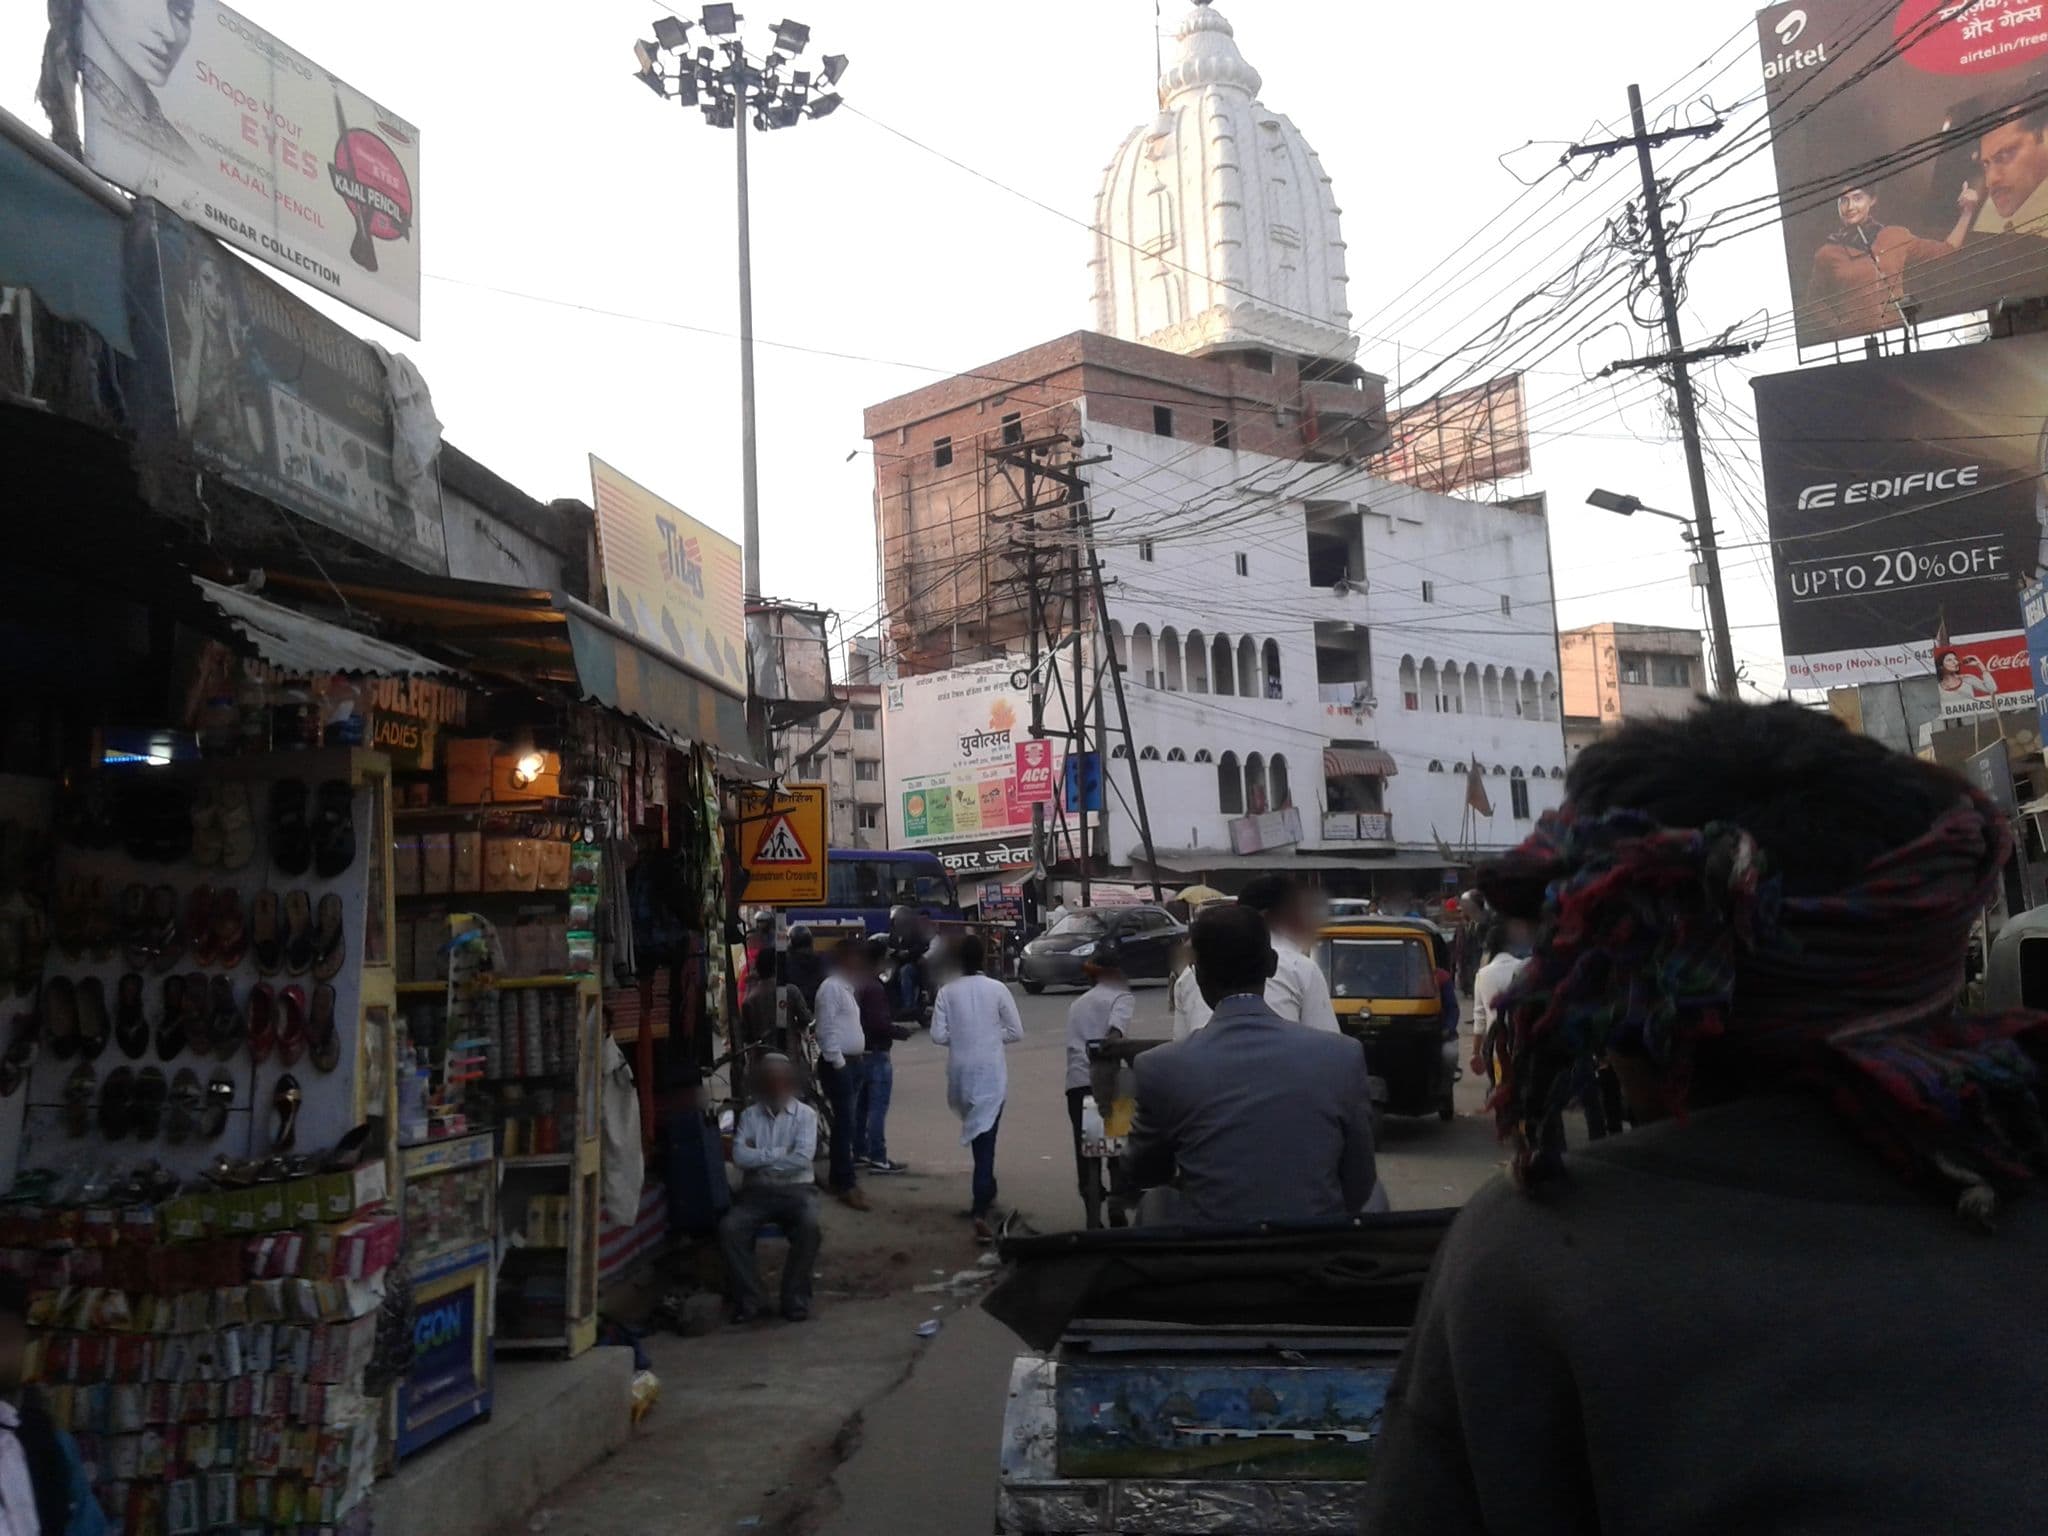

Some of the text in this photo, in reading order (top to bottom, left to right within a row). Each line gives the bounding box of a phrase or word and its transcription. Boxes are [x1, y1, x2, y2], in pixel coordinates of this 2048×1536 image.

[1961, 18, 1994, 40] और
[1763, 42, 1827, 79] airtel
[196, 59, 303, 137] Shape Your
[240, 112, 318, 180] EYES
[219, 159, 325, 229] KAJAL PENCIL
[334, 173, 403, 223] KAJAL PENCIL
[204, 202, 341, 286] SINGAR COLLECTION
[1844, 465, 1980, 505] EDIFICE
[1791, 565, 1867, 596] UPTO
[1789, 663, 1810, 677] Big
[1812, 661, 1843, 674] Shop
[1846, 657, 1881, 671] (Nova
[1997, 695, 2018, 708] PAN
[374, 719, 418, 749] LADIES
[960, 728, 1011, 757] युवोत्सव
[1020, 767, 1050, 783] ACC
[785, 870, 818, 884] Crossing
